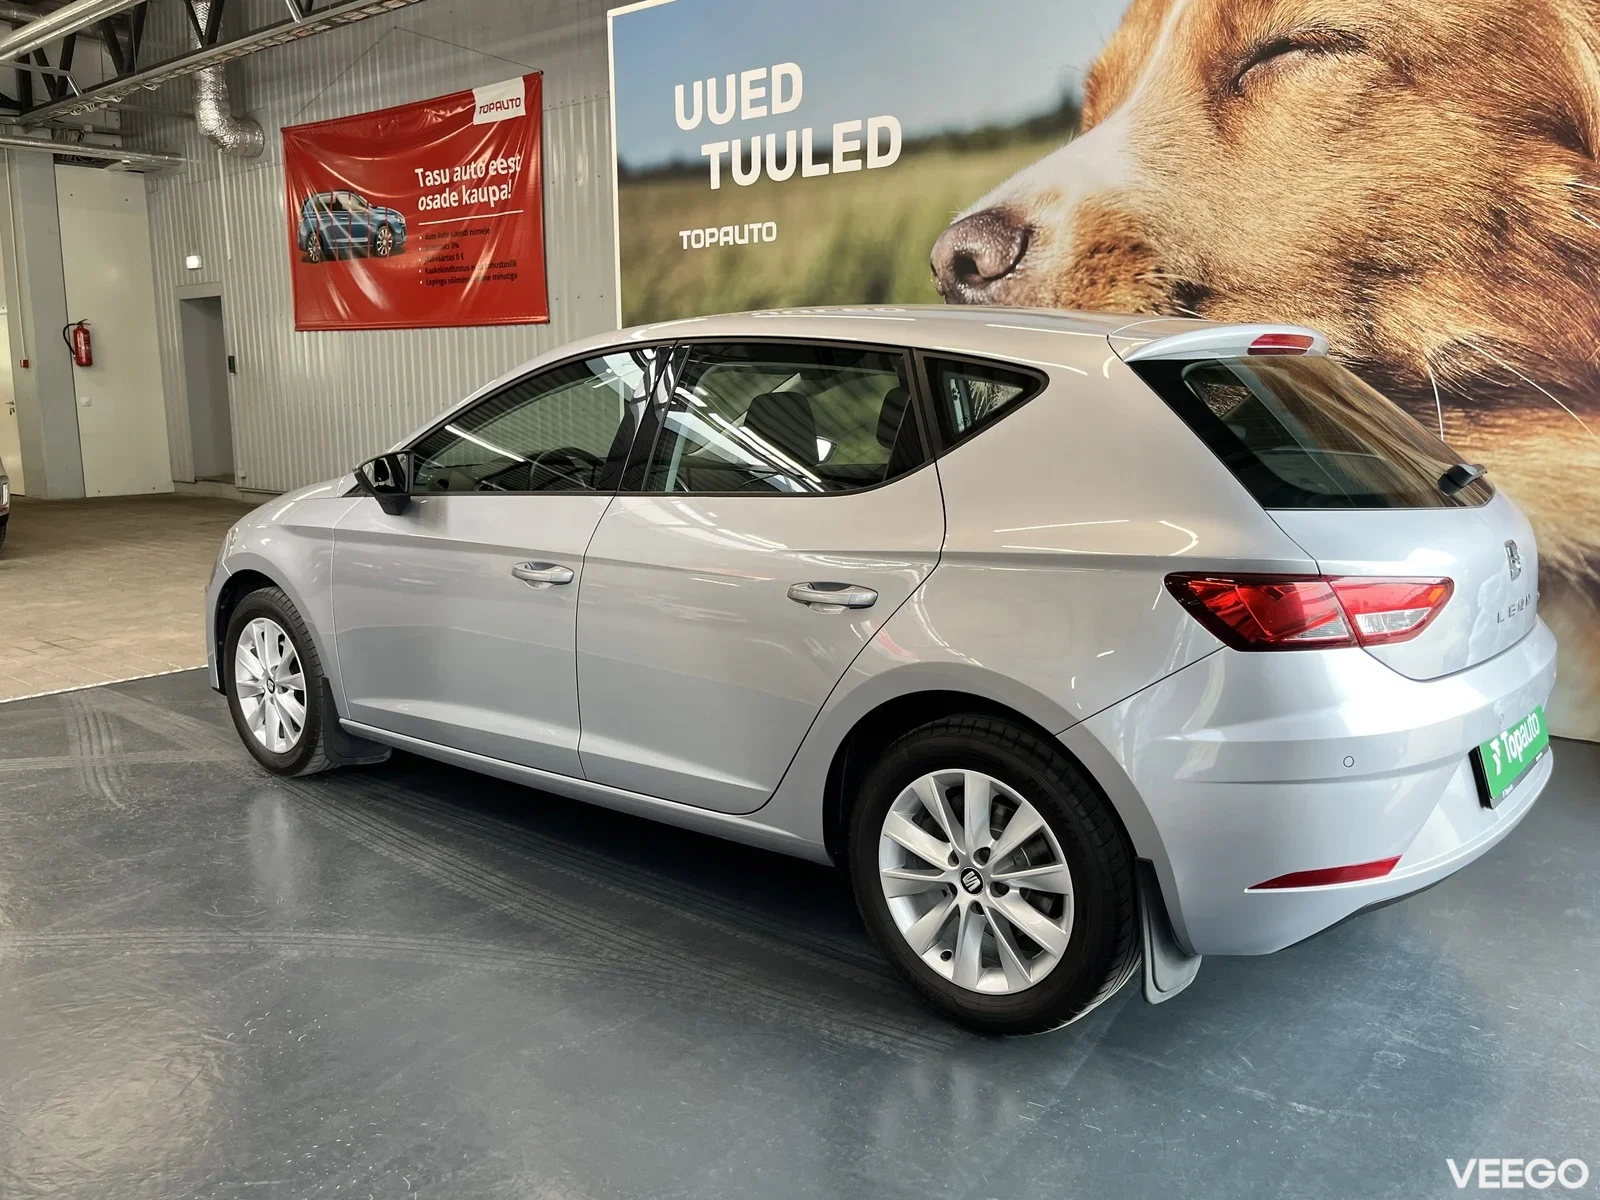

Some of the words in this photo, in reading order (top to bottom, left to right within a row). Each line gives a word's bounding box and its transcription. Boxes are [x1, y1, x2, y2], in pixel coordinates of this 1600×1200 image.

[479, 97, 521, 115] TOPAUTO
[675, 62, 803, 131] UUED
[701, 115, 902, 190] TUULED
[415, 168, 449, 187] Tasu
[453, 161, 486, 182] auto
[489, 154, 521, 176] eest
[418, 187, 459, 211] osade
[462, 179, 512, 207] kaupa!
[679, 221, 777, 250] TOPAUTO
[1500, 712, 1540, 764] Topauto
